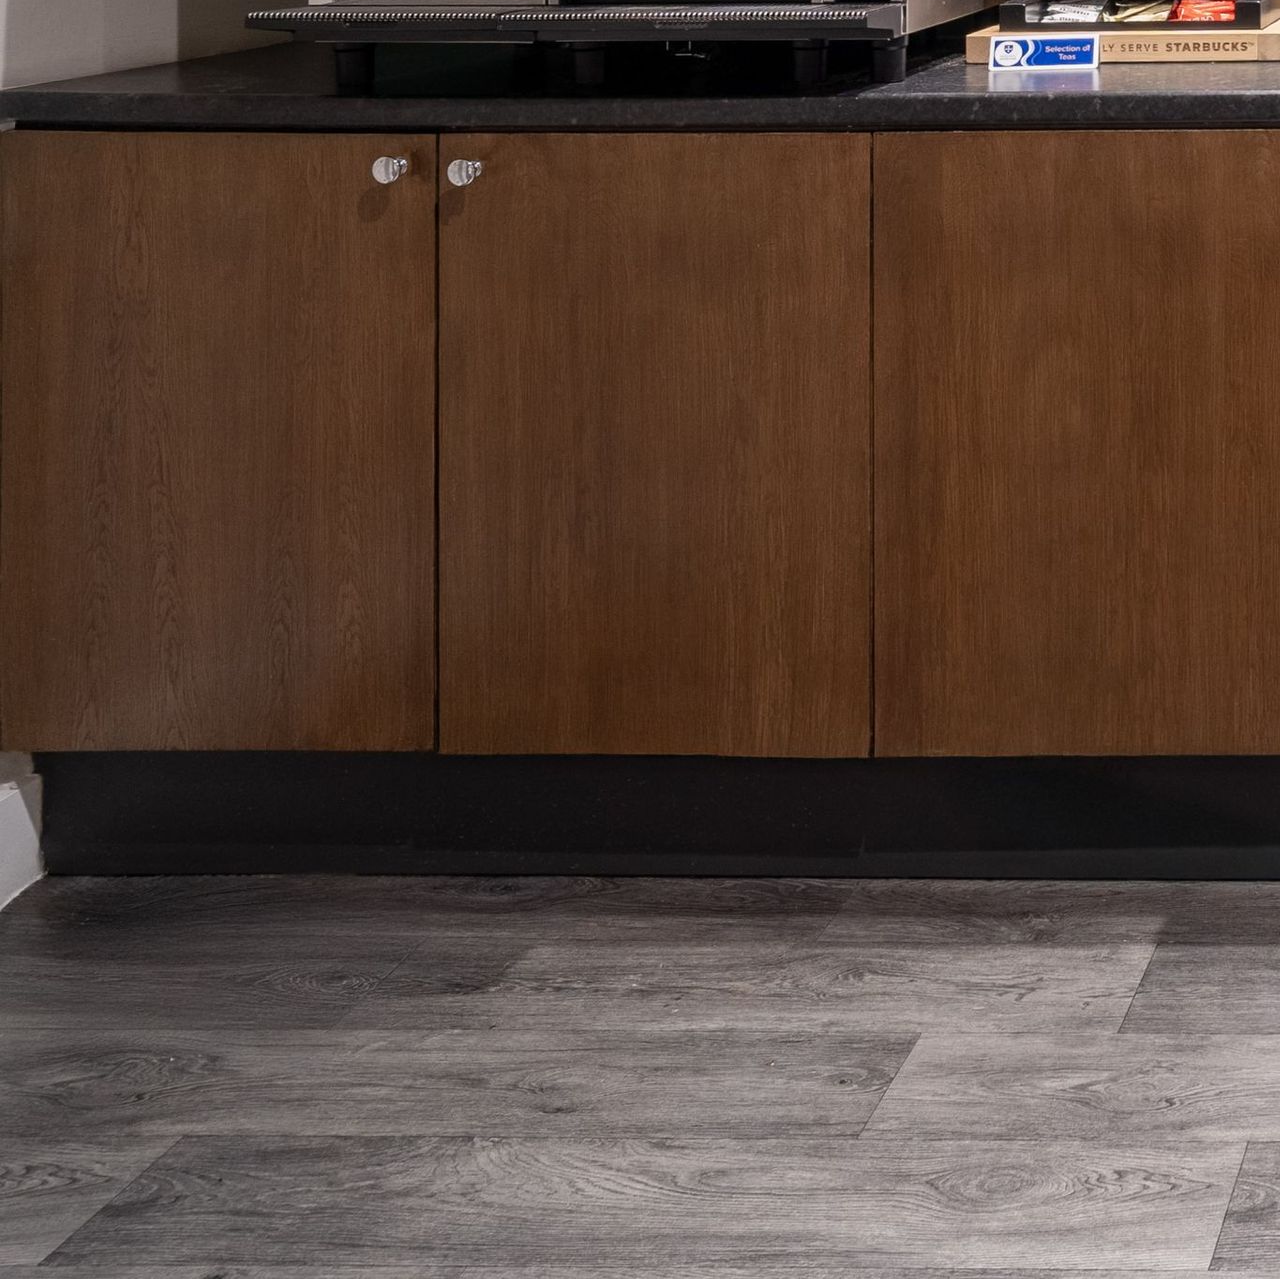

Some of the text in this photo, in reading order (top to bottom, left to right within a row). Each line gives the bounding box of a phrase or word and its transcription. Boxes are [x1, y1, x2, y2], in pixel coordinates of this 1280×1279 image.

[1045, 44, 1091, 53] Selection of
[1120, 43, 1159, 52] SERVE
[1059, 53, 1076, 61] Teas
